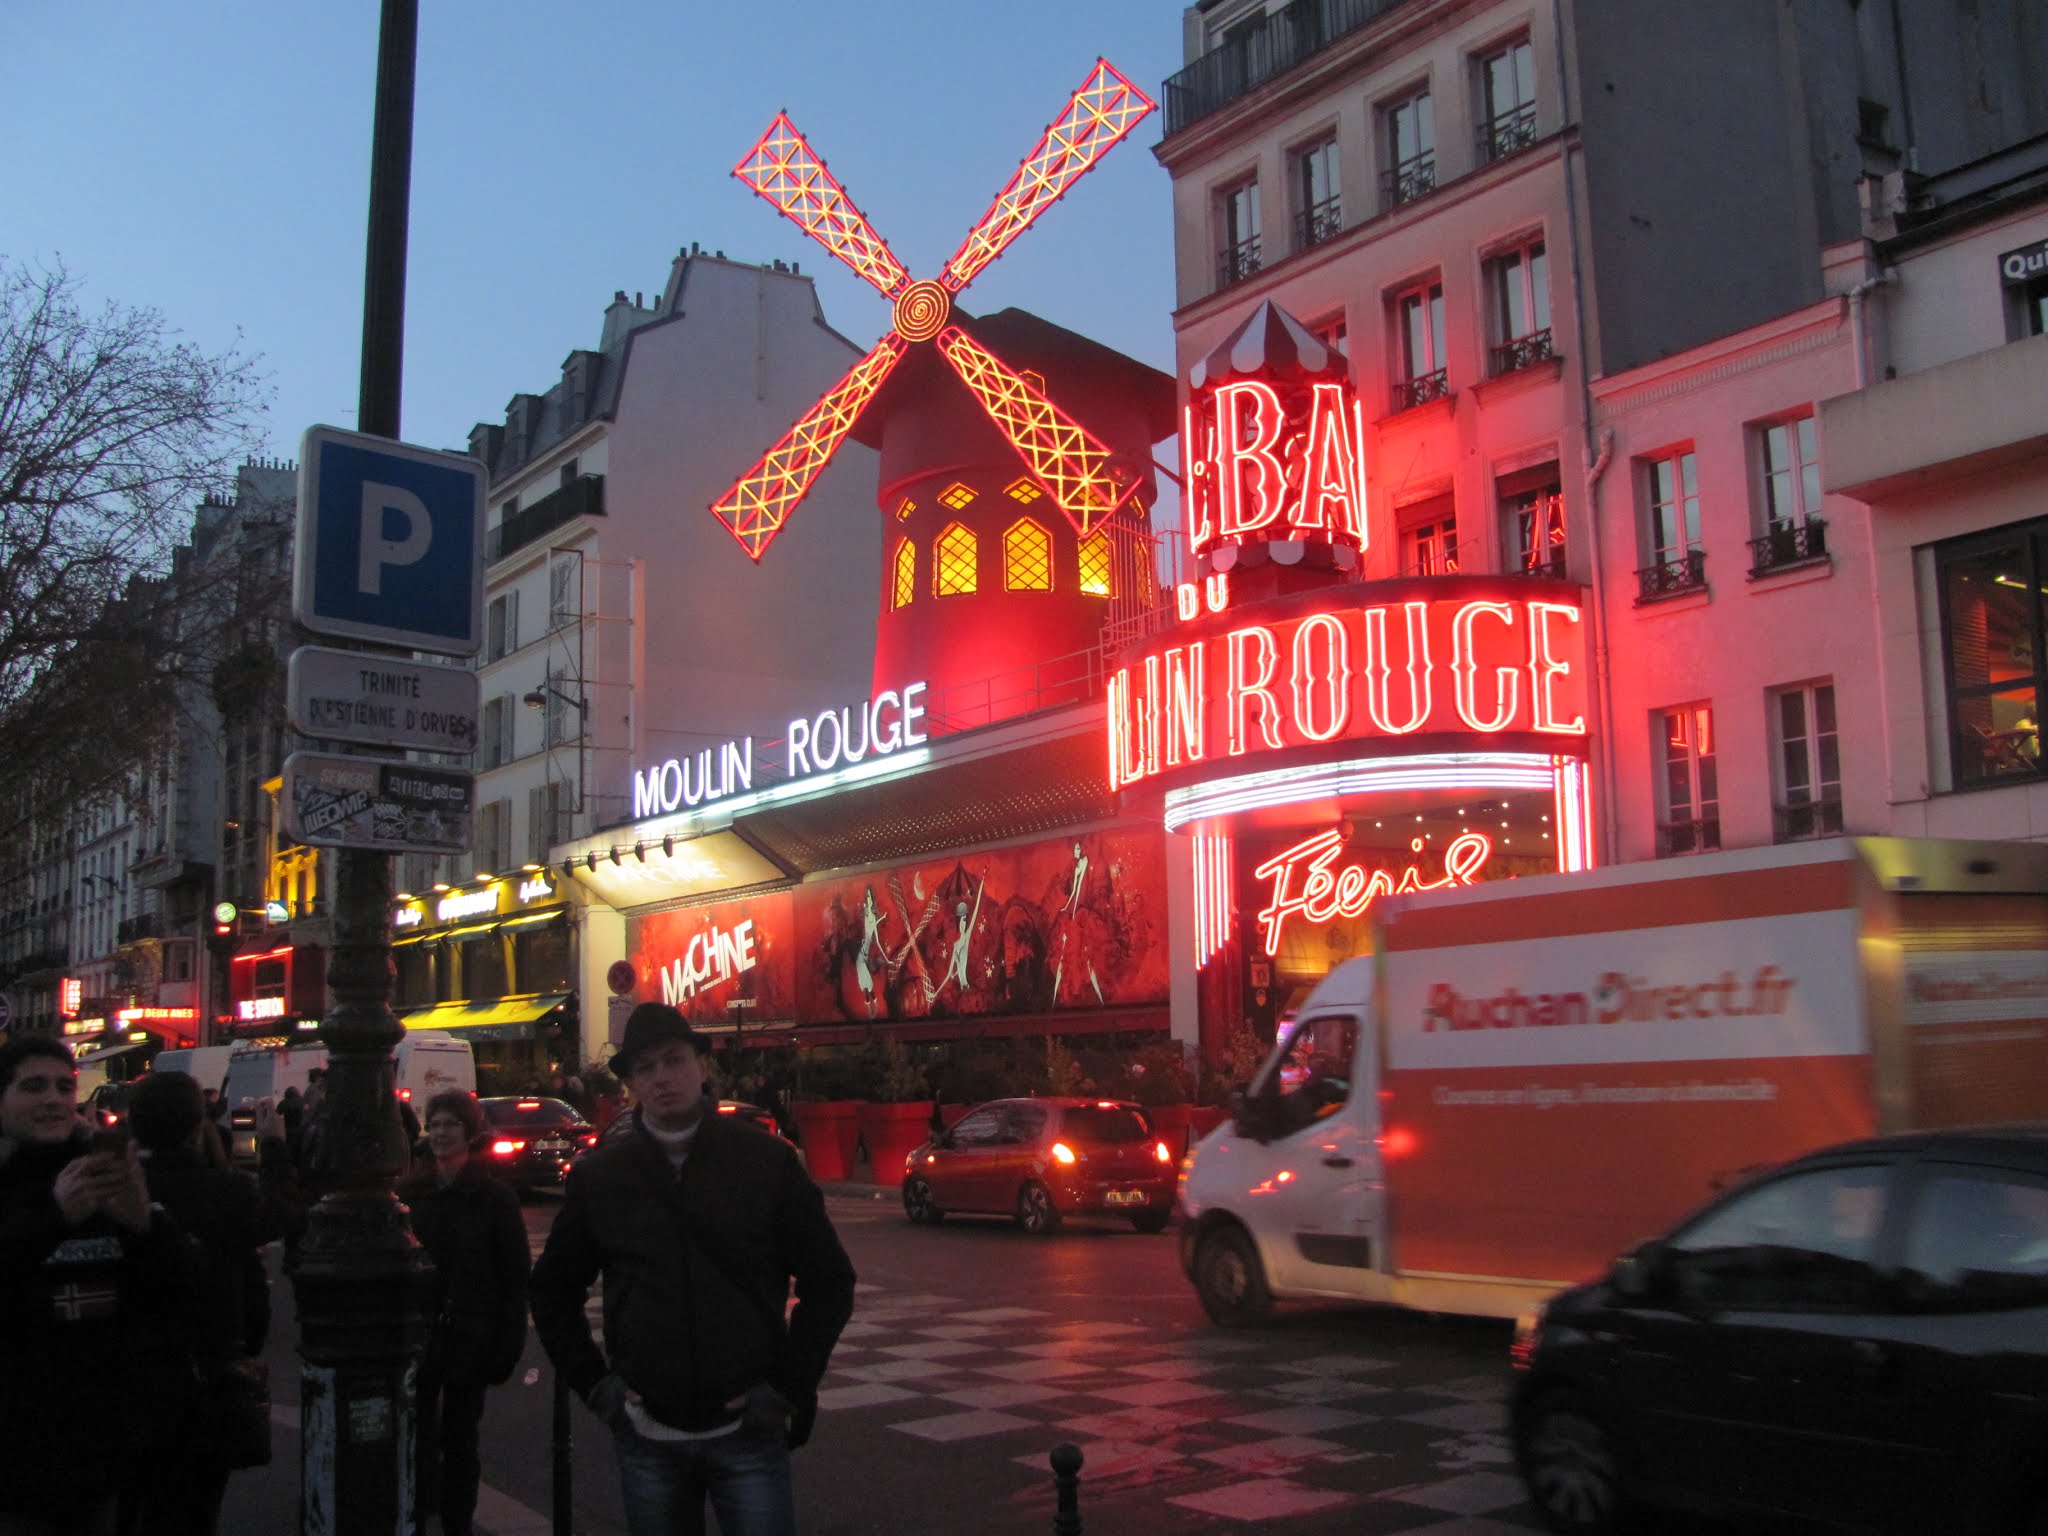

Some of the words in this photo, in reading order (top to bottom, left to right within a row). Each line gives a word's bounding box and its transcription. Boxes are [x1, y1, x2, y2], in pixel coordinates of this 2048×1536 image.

[1215, 381, 1367, 552] BA
[357, 480, 433, 595] P
[1177, 573, 1228, 621] DU
[360, 669, 421, 698] TRINITÉ
[1108, 642, 1203, 792] LIN
[1228, 602, 1586, 755] ROUGE
[635, 736, 752, 818] MOULIN
[788, 681, 927, 777] ROUGE
[661, 919, 757, 1007] MACHINE
[144, 1009, 169, 1018] DEUX
[298, 1020, 319, 1029] BAR
[1422, 983, 1590, 1032] Auchan
